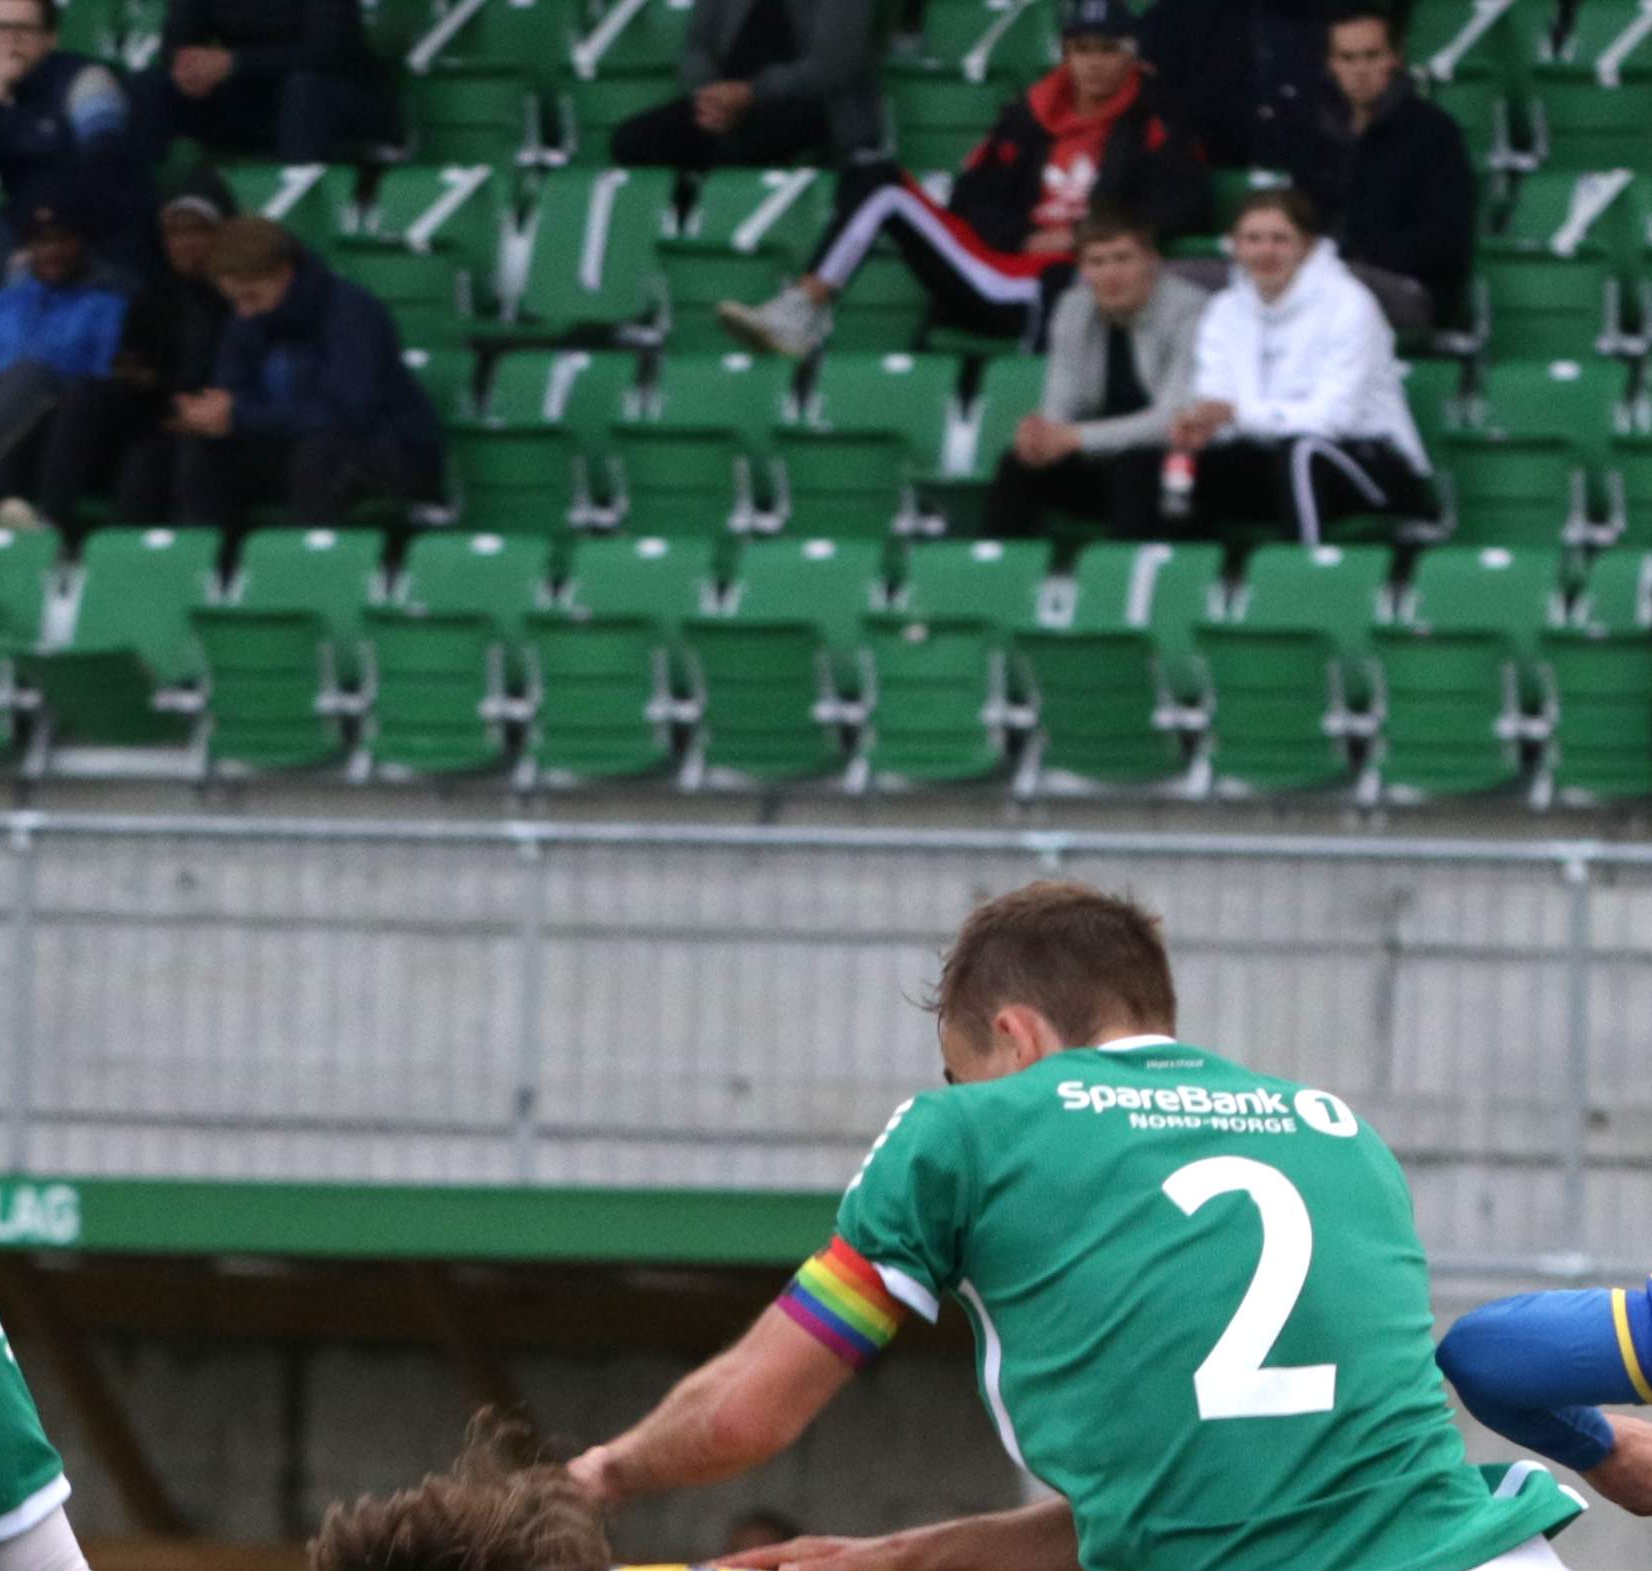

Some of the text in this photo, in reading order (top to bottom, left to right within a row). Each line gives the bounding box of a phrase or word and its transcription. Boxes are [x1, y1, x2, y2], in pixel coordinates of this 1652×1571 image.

[1056, 1080, 1290, 1115] SpareBank
[1128, 1112, 1298, 1134] NORD-NORGE
[1162, 1155, 1337, 1421] 2
